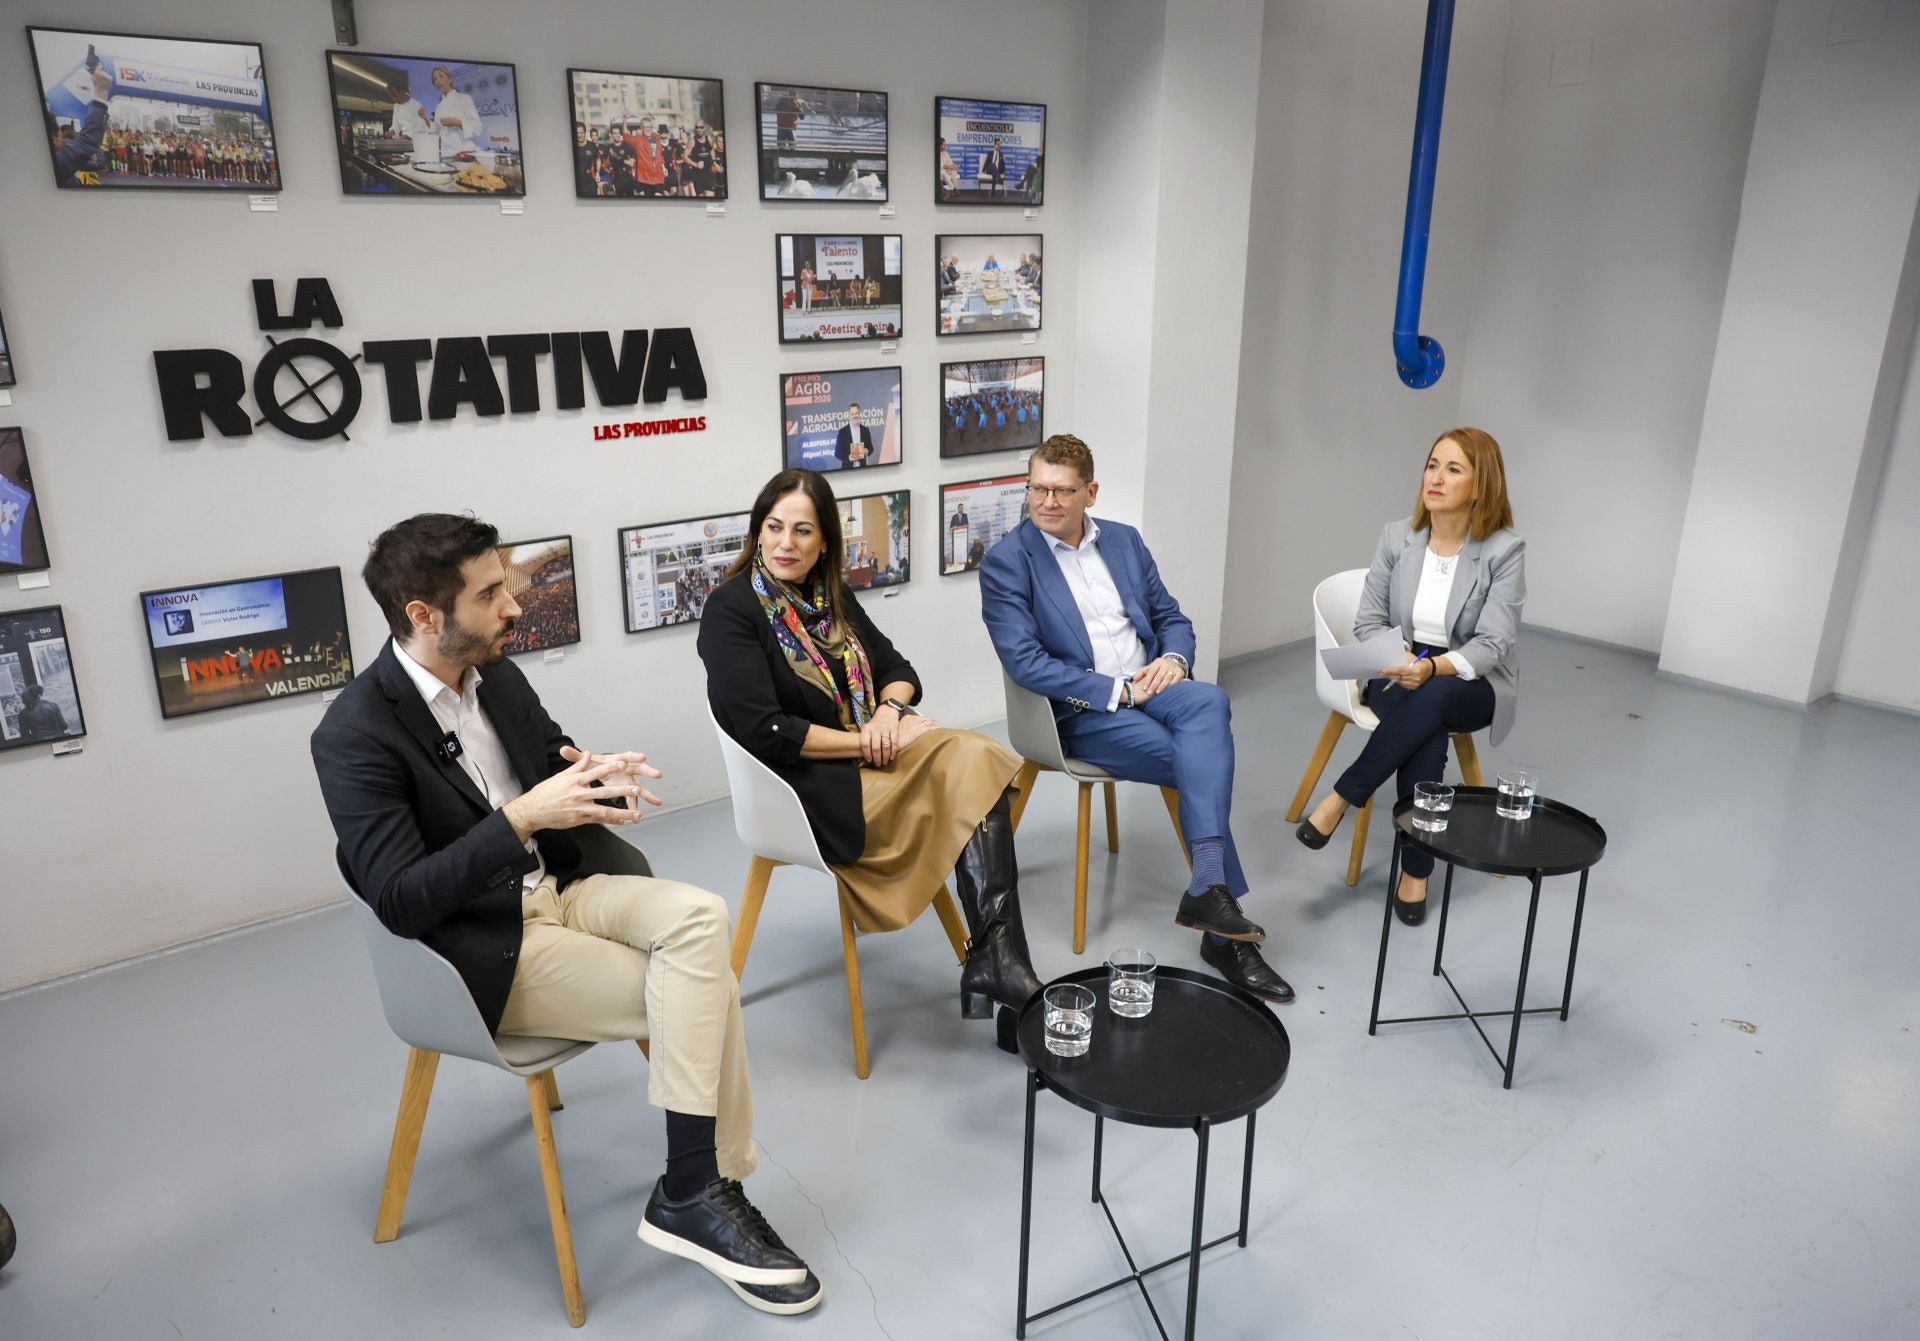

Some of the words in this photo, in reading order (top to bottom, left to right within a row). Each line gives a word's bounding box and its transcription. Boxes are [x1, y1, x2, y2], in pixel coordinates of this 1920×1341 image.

[118, 67, 146, 83] 15K
[196, 80, 212, 92] LAS
[213, 82, 259, 98] PROVINCIAS
[821, 246, 858, 257] Talento
[252, 278, 343, 330] LA
[819, 323, 862, 335] Meeting
[153, 327, 708, 441] ROTATIVA
[795, 381, 832, 396] AGRO
[813, 394, 832, 403] 2020
[801, 407, 884, 425] TRANSFORACIÓN
[593, 424, 622, 441] LAS
[623, 416, 707, 438] PROVINCIAS
[265, 671, 347, 697] VALENCIA
